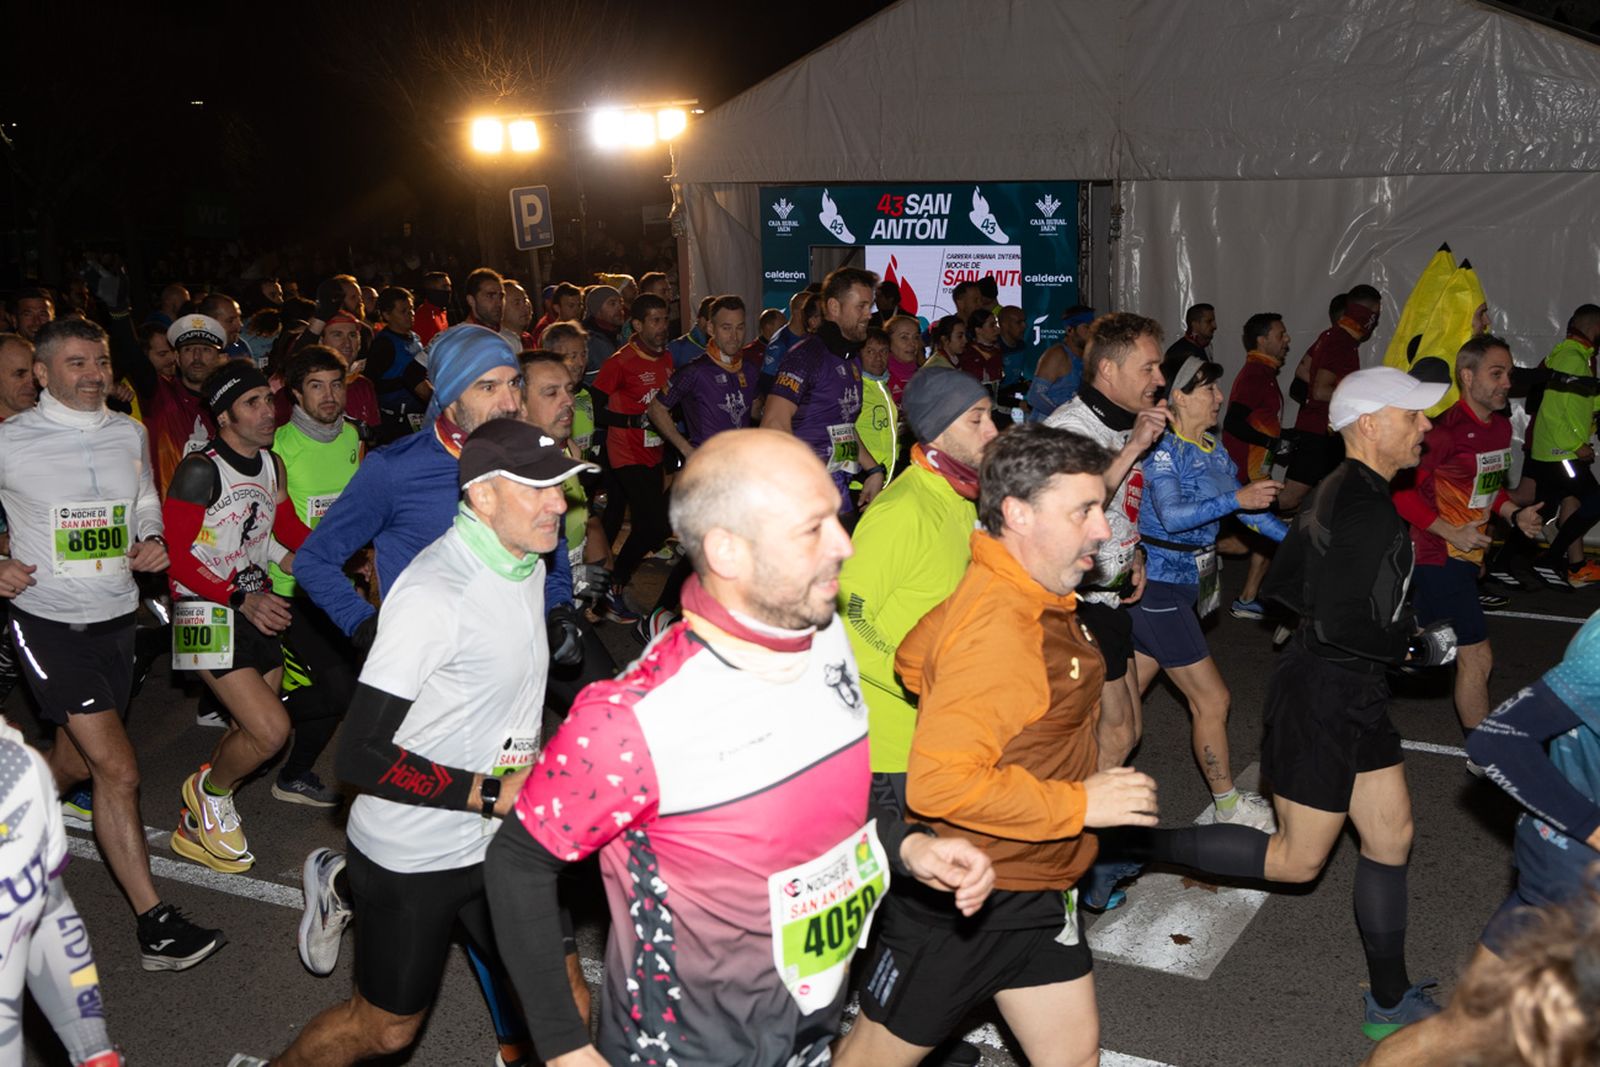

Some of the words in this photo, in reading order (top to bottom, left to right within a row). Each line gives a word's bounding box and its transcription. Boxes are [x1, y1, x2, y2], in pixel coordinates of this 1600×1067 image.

[876, 193, 904, 216] 43
[904, 193, 952, 215] SAN
[520, 194, 543, 242] P
[829, 219, 844, 235] 43
[870, 212, 948, 239] ANTÓN
[980, 218, 996, 235] 43
[943, 270, 980, 286] SAN
[71, 511, 96, 519] NOCHE
[206, 496, 232, 516] CLUB
[61, 520, 79, 529] SAN
[68, 527, 122, 552] 8690
[183, 626, 212, 646] 970
[790, 898, 819, 920] SAN
[803, 884, 876, 958] 4050
